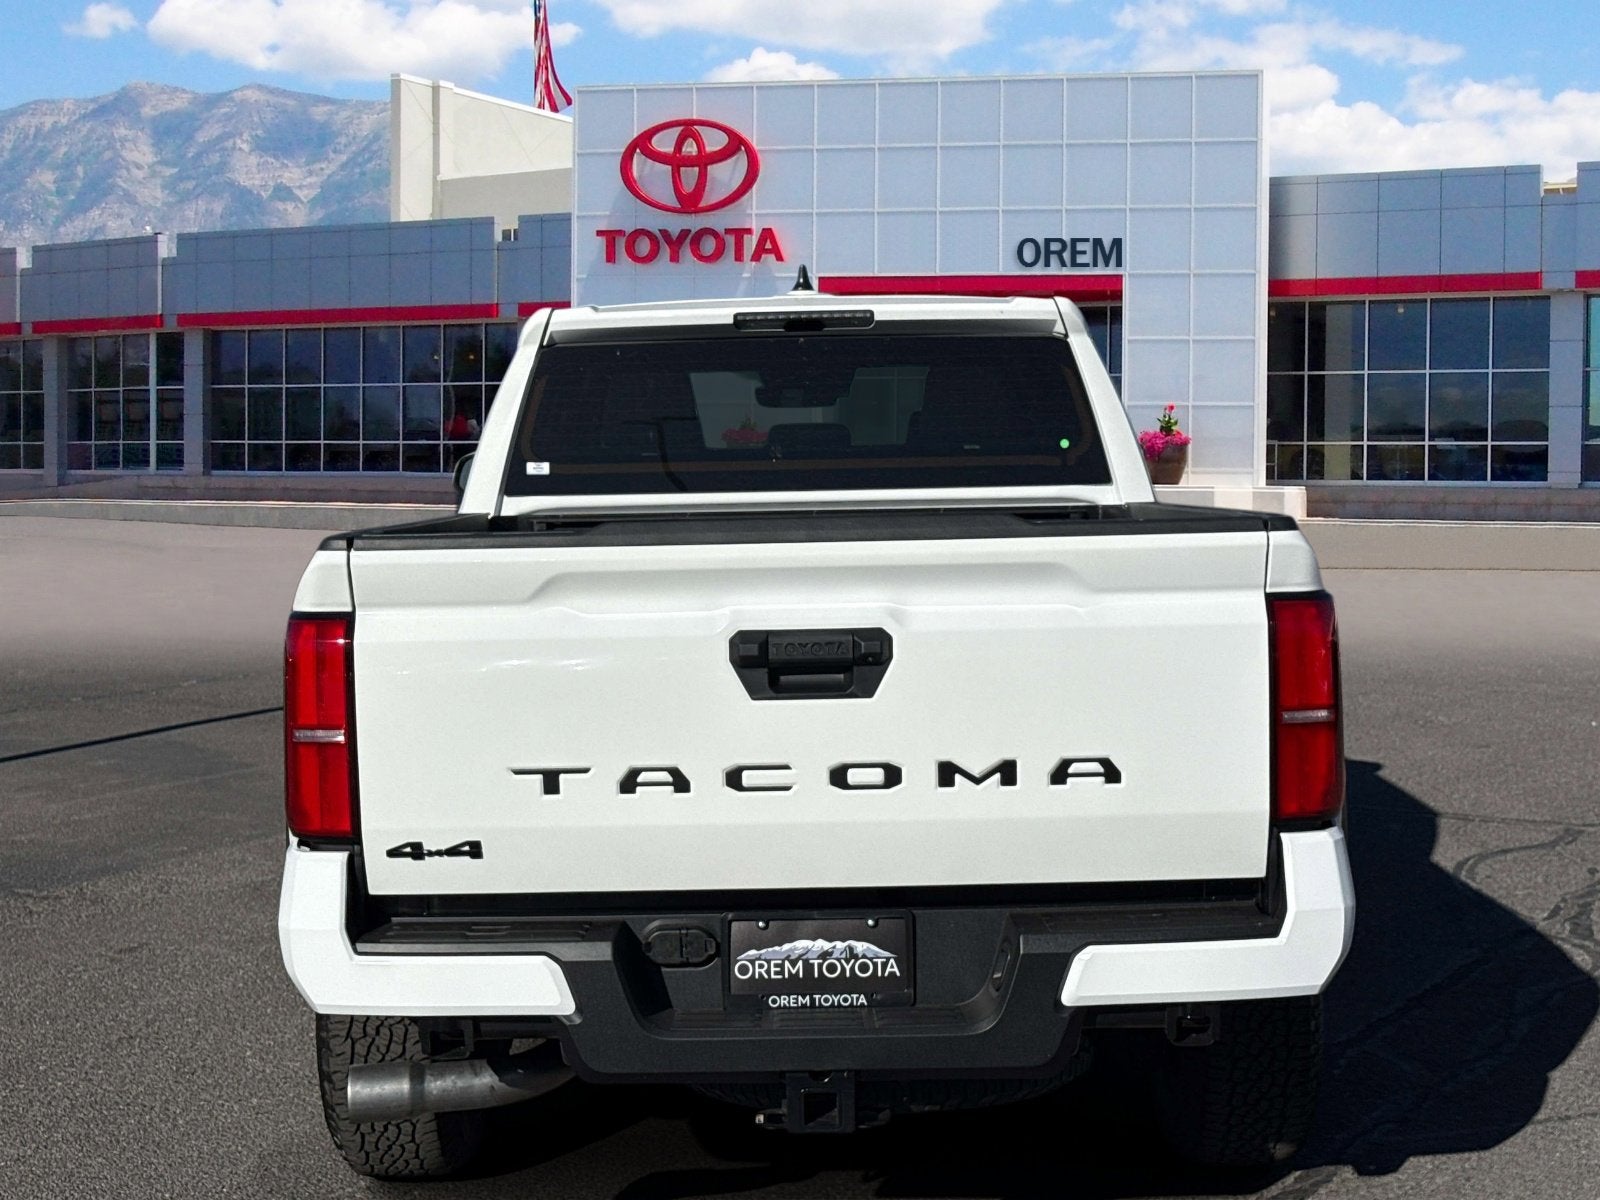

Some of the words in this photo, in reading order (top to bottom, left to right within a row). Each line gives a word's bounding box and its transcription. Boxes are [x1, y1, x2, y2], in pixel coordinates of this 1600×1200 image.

[596, 227, 785, 264] TOYOTA
[1016, 237, 1123, 268] OREM
[772, 640, 848, 657] TOYOTA
[508, 757, 1122, 796] TACOMA
[734, 959, 803, 979] OREM
[809, 958, 900, 978] TOYOTA
[768, 994, 809, 1008] OREM
[813, 993, 867, 1007] TOYOTA
